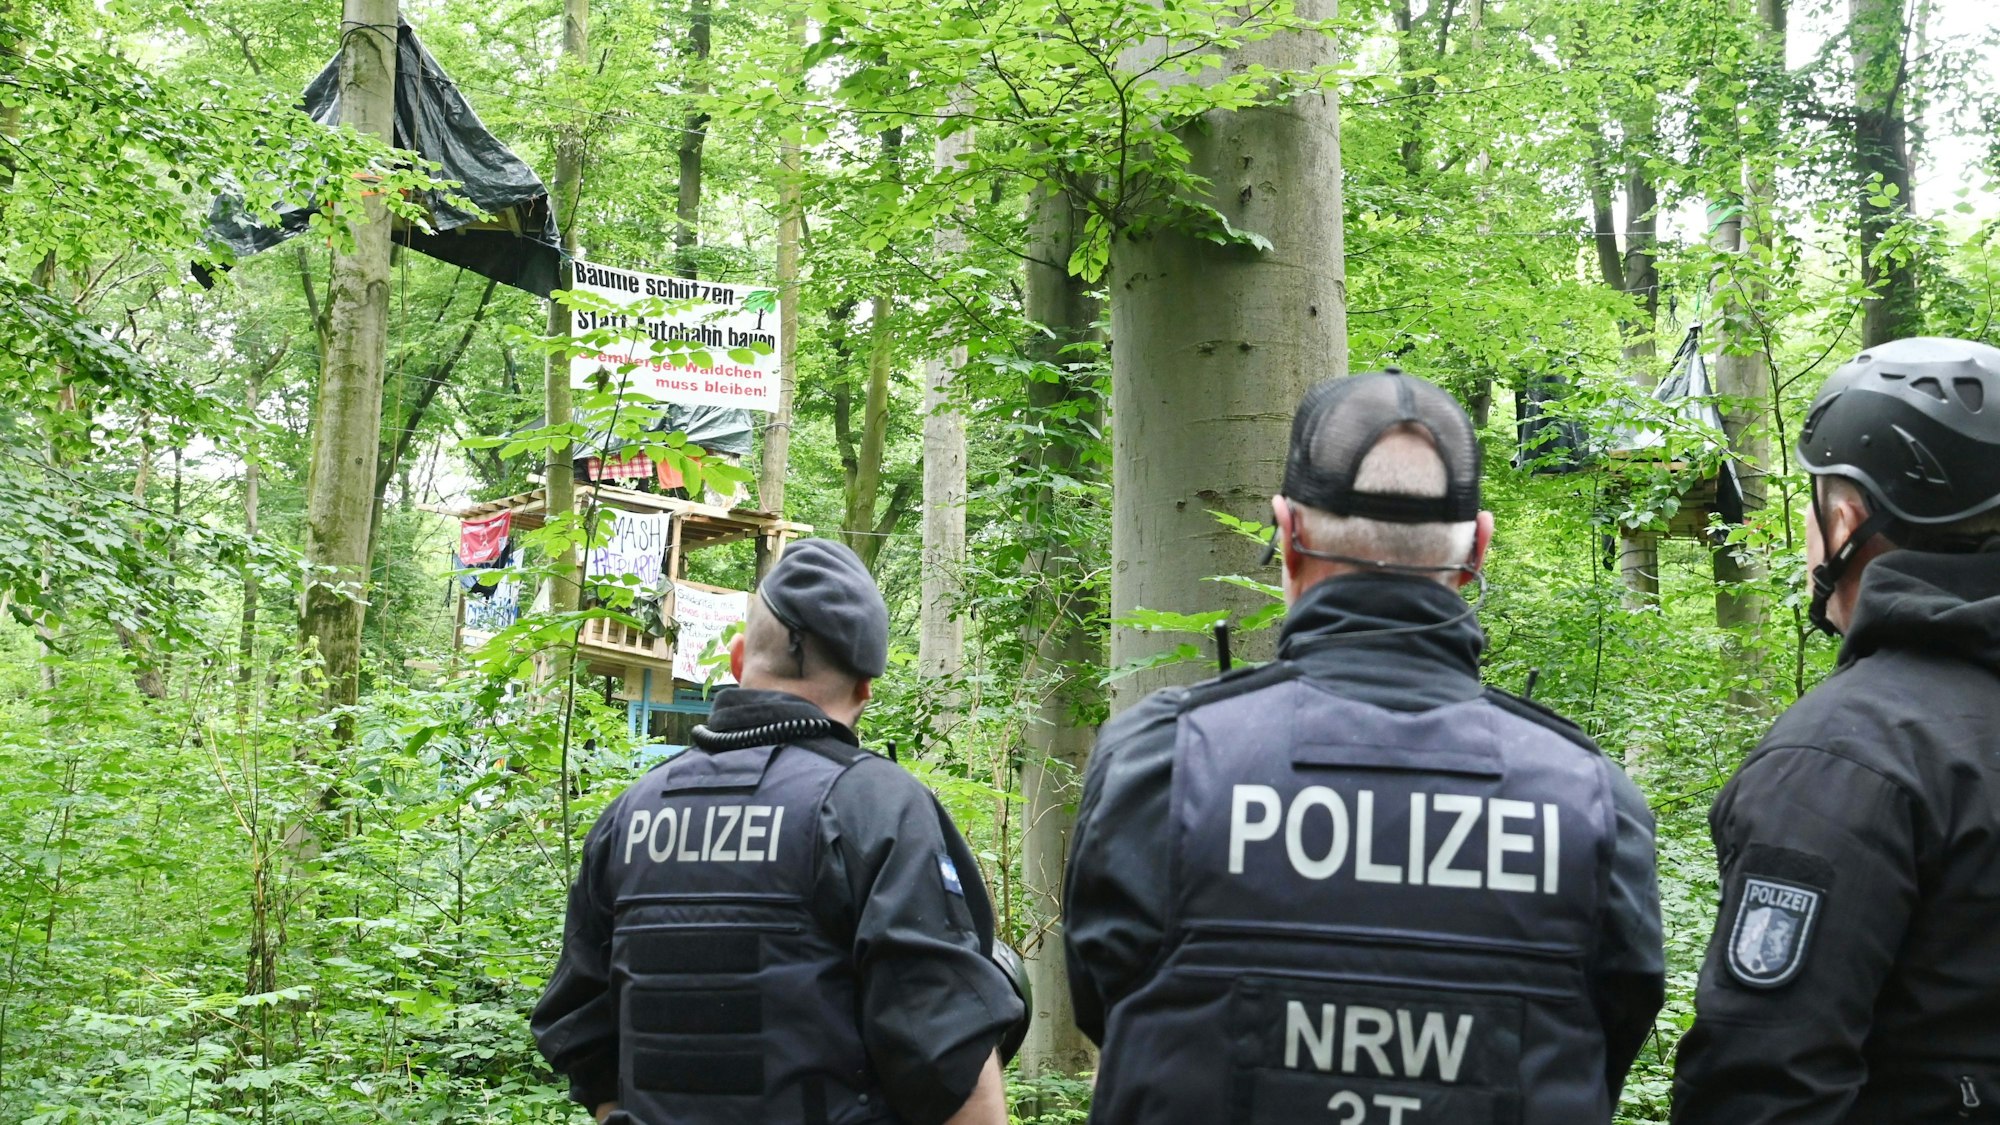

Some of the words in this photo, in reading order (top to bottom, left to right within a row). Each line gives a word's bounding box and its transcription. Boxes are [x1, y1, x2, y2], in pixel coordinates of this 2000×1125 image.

[575, 261, 639, 293] Bäume
[645, 278, 734, 305] schützen
[656, 378, 698, 391] muss
[705, 381, 767, 397] bleiben!
[608, 516, 661, 555] MASH
[625, 805, 784, 864] POLIZEI
[1228, 784, 1560, 894] POLIZEI
[1750, 884, 1809, 913] POLIZEI
[1284, 1001, 1474, 1082] NRW
